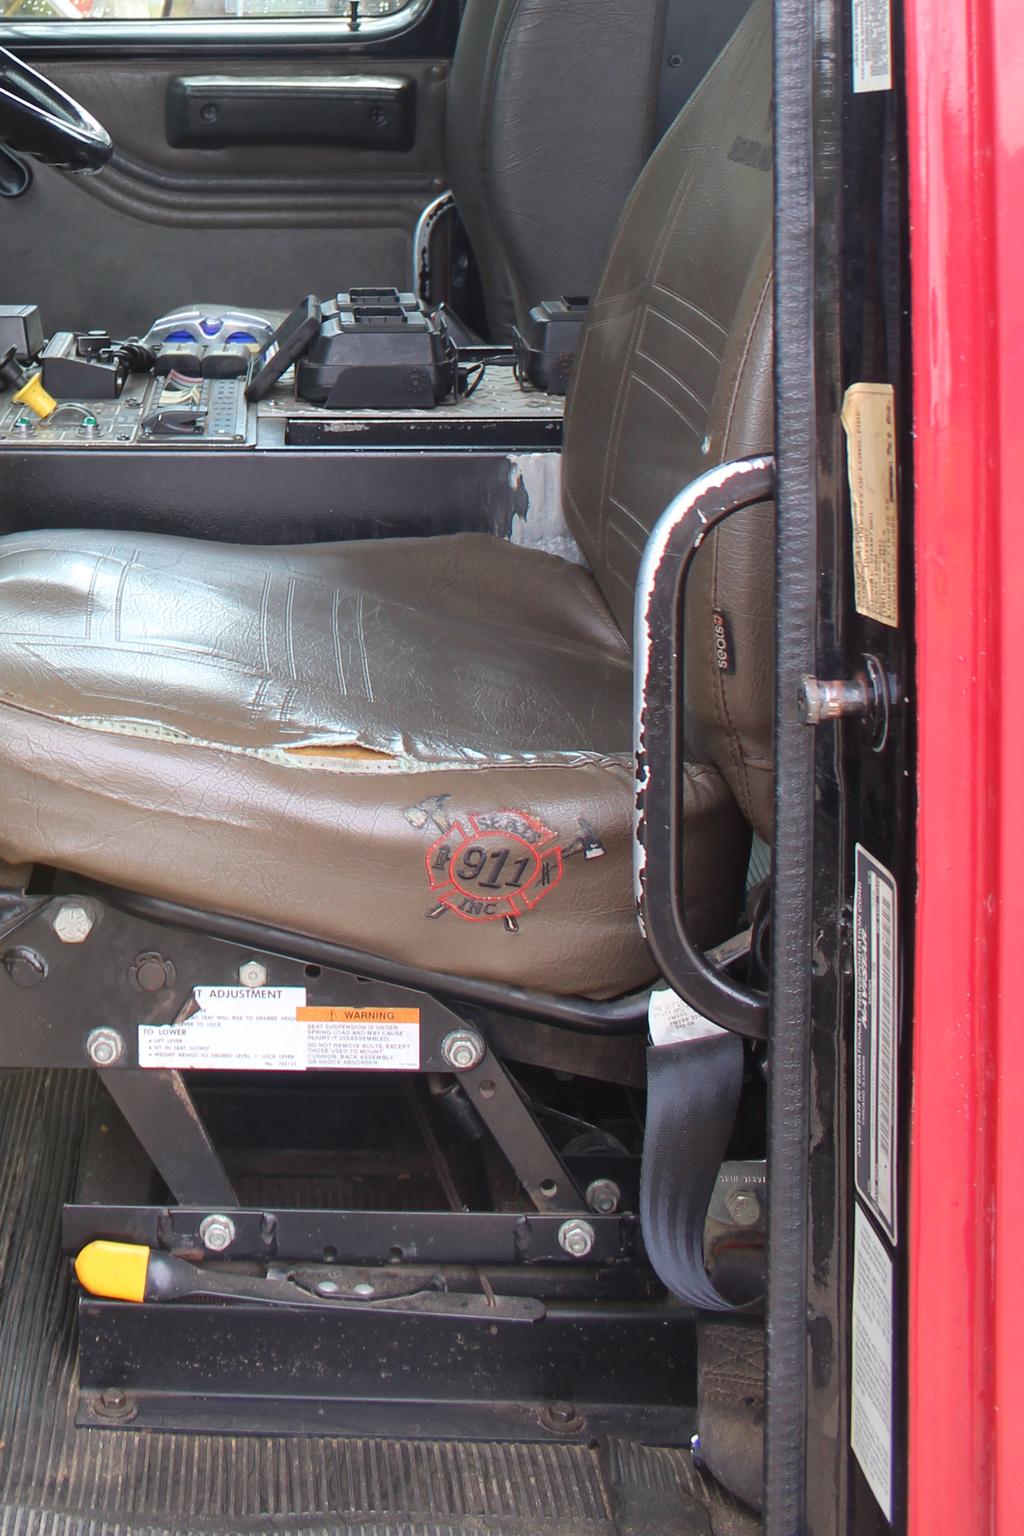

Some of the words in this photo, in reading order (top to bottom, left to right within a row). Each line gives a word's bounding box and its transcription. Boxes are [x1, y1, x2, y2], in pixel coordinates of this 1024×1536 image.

[457, 845, 530, 889] 911
[458, 897, 498, 915] INC
[209, 989, 283, 999] ADJUSTMENT
[344, 1011, 395, 1020] WARNING
